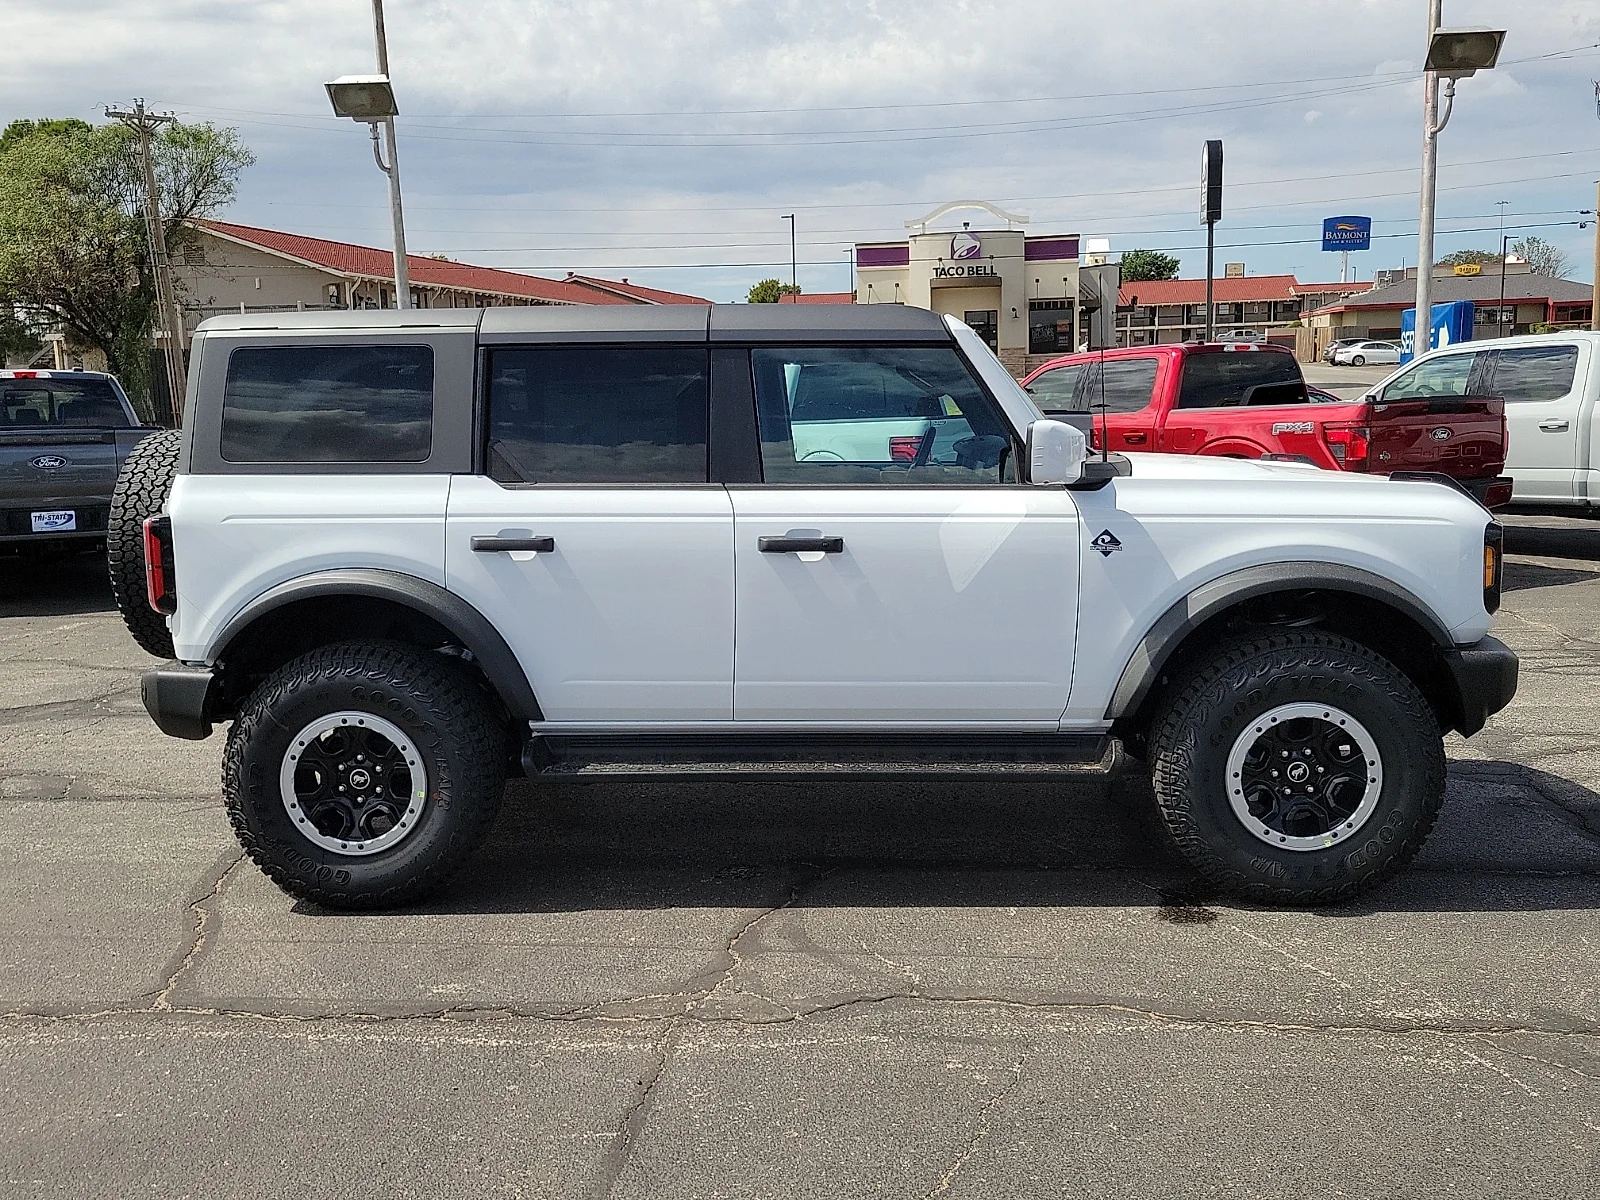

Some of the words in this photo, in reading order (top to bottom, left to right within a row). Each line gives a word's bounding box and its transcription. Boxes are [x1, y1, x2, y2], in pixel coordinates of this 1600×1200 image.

[1325, 231, 1369, 240] BAYMONT
[932, 266, 965, 277] TACO
[967, 265, 998, 276] BELL
[1272, 422, 1314, 434] FX4
[1433, 429, 1450, 440] Ford
[36, 457, 62, 467] Ford
[33, 513, 67, 522] TRI-STATE
